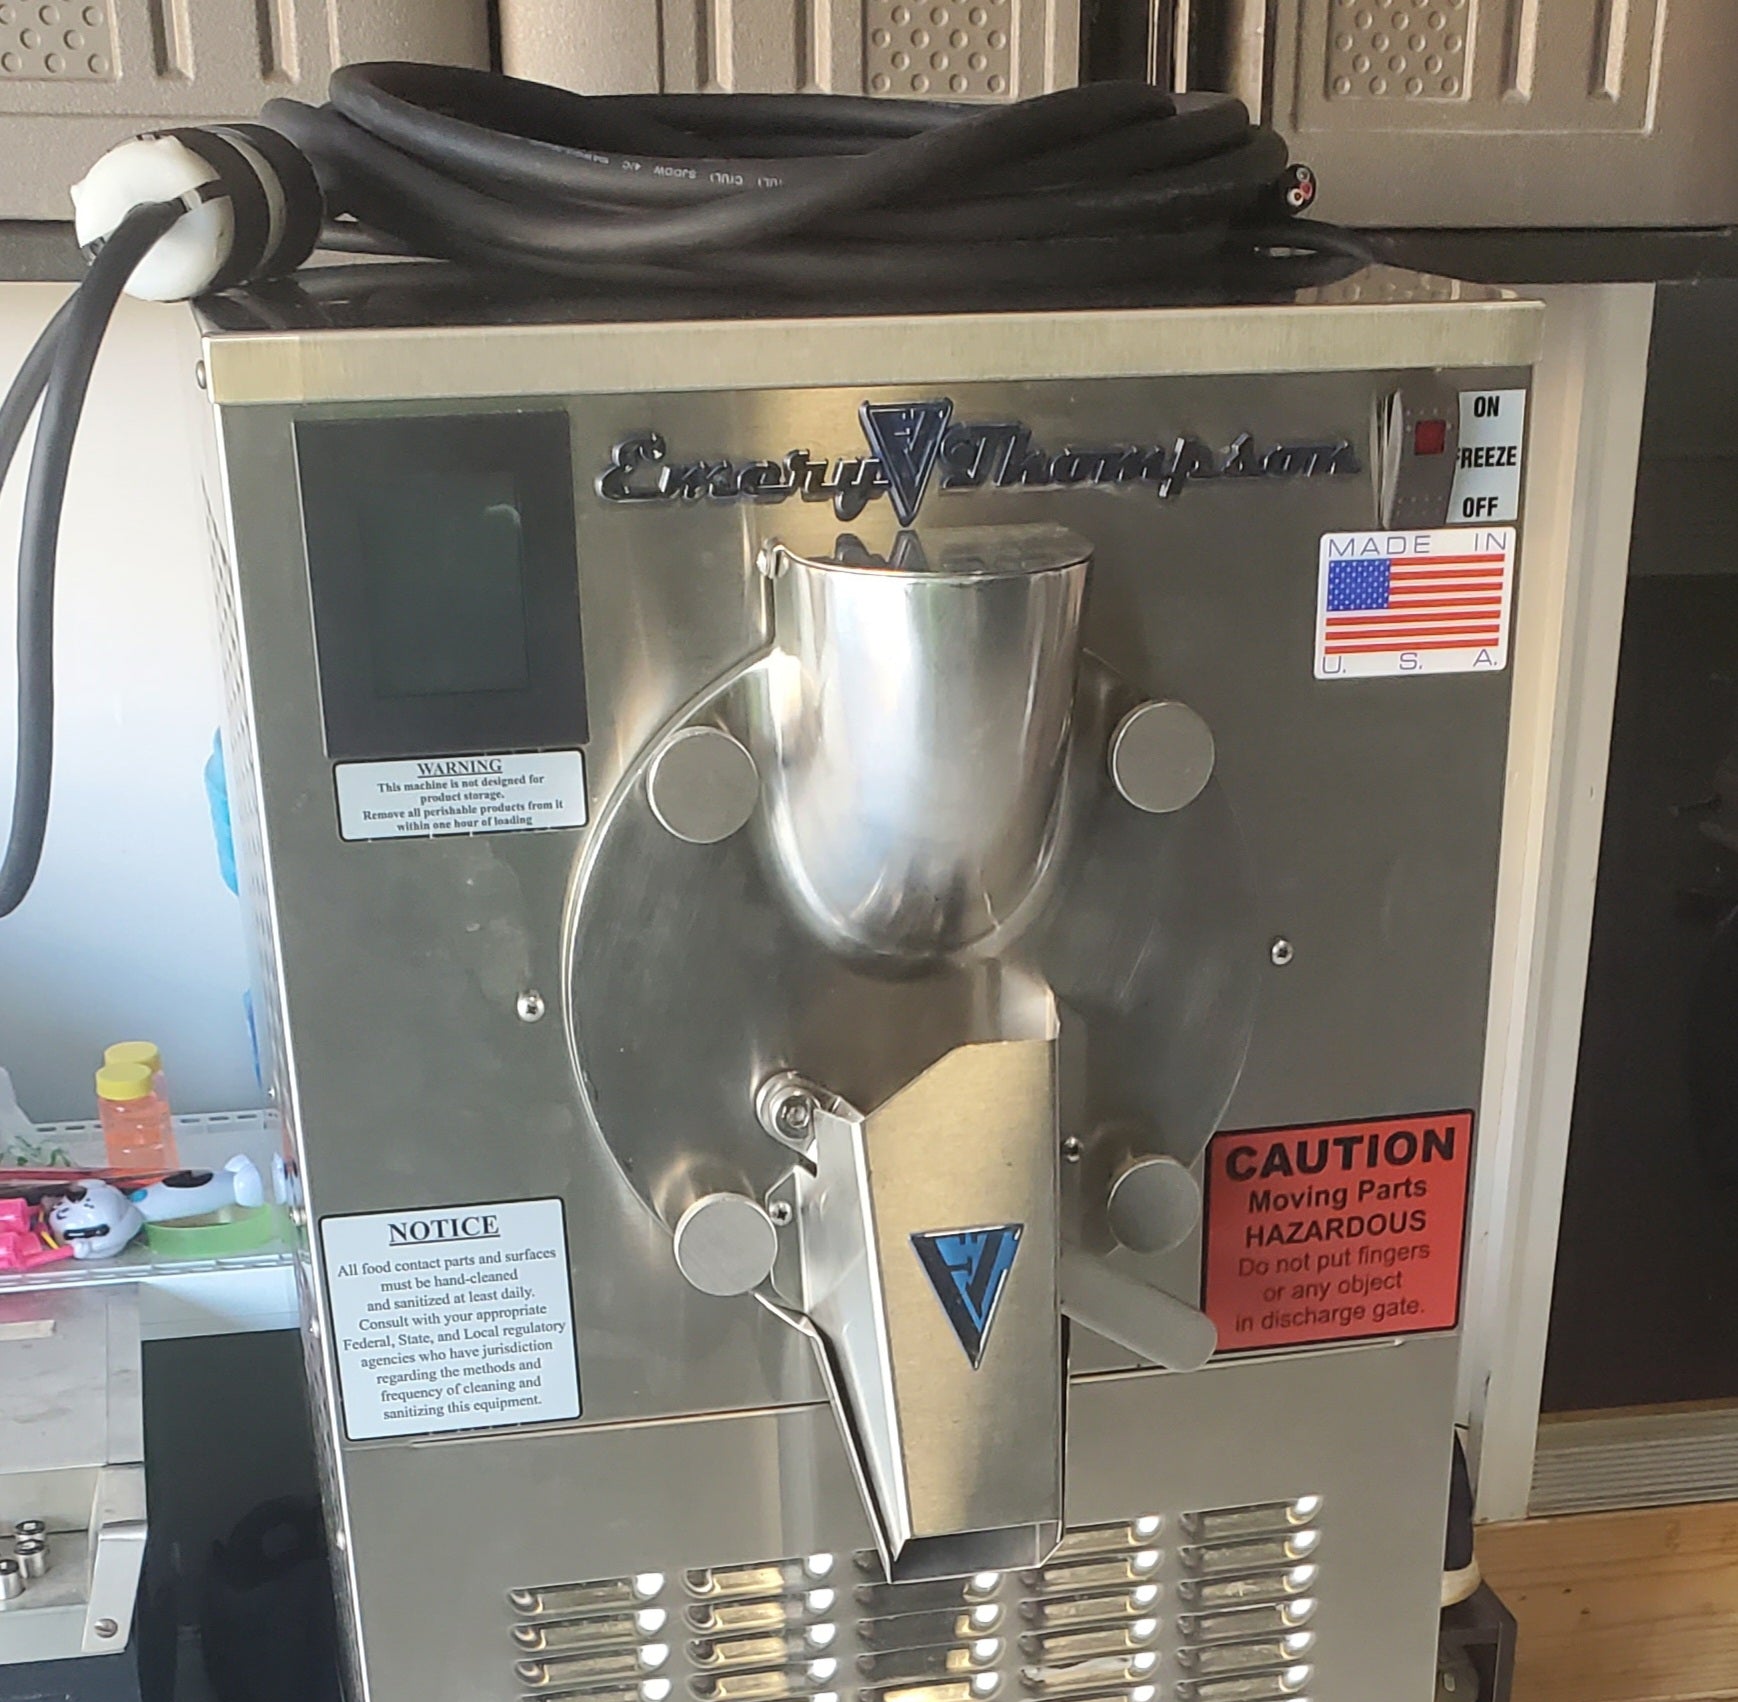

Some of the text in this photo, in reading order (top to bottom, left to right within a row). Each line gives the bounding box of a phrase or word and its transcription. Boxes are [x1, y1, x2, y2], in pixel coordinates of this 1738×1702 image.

[1474, 396, 1499, 418] ON
[1456, 446, 1517, 468] REEZE
[596, 431, 888, 521] Emery
[938, 421, 1361, 498] Thompson
[1462, 497, 1498, 518] OFF
[1329, 532, 1506, 558] MADE IN
[417, 759, 502, 778] WARNING
[377, 775, 544, 793] This machine is not designed for
[363, 800, 563, 821] Remove all perishable products from it
[420, 791, 504, 806] product storage.
[397, 815, 533, 831] within one hour of loading
[1225, 1127, 1455, 1182] CAUTION
[1249, 1177, 1427, 1213] Moving Parts
[388, 1215, 500, 1246] NOTICE
[1246, 1210, 1426, 1248] HAZARDOUS
[338, 1248, 556, 1277] All food contact parts and surfaces
[1239, 1243, 1430, 1277] Do not put fingers
[381, 1268, 518, 1292] must be hand-cleaned
[1263, 1271, 1403, 1302] or any object
[367, 1286, 535, 1311] and sanitized at least daily.
[359, 1304, 547, 1330] Consult with your appropriate
[1235, 1297, 1424, 1332] in discharge gate.
[343, 1321, 566, 1350] Federal, State, and Local regulatory
[361, 1340, 553, 1369] agencies who have jurisdiction
[376, 1358, 541, 1386] regarding the methods and
[381, 1376, 541, 1403] frequency of cleaning and
[383, 1395, 542, 1420] sanitizing this equipment.
